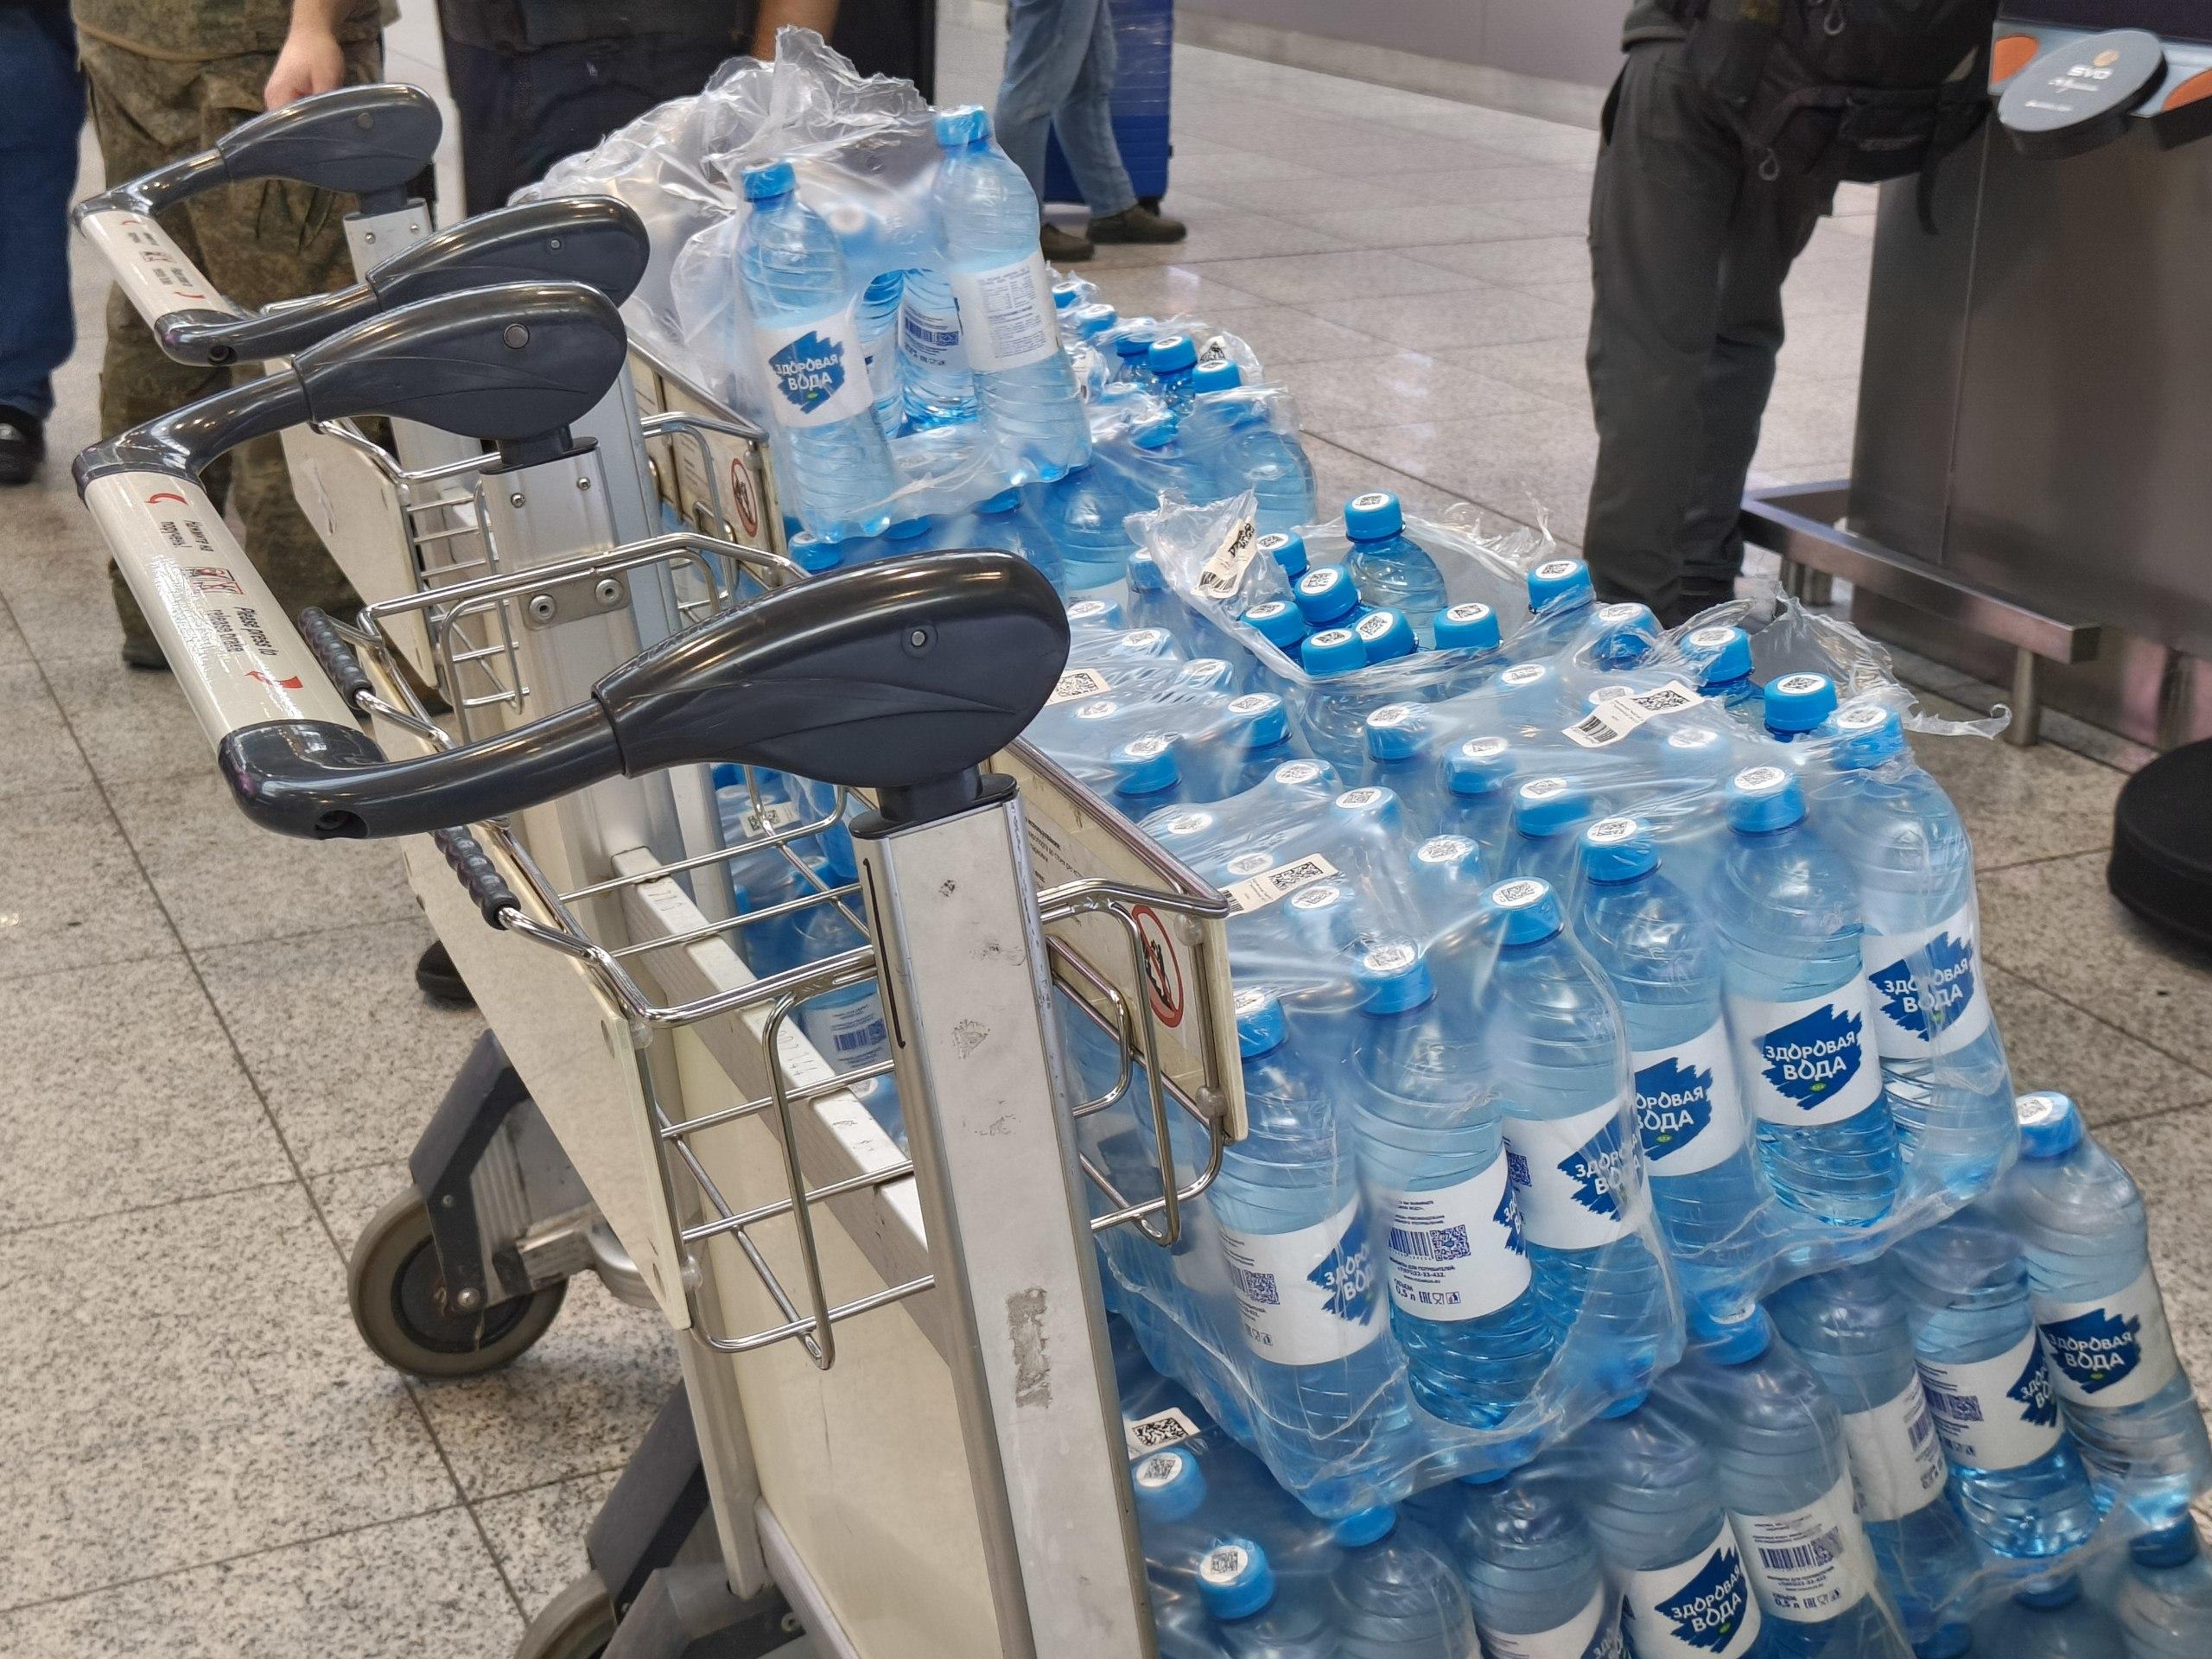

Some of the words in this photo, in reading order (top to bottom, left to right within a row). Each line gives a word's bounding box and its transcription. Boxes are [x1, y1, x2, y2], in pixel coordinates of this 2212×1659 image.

[775, 354, 838, 375] ЗДОРОВАЯ
[788, 372, 833, 391] ВОДА
[207, 609, 233, 632] release
[233, 607, 260, 628] Please
[240, 627, 272, 648] press
[1884, 958, 1968, 995] ЗДООВАЯ
[1903, 983, 1963, 1013] ВОДА
[1765, 1031, 1855, 1062] ЗДОРОВАЯ
[1783, 1056, 1847, 1081] ВОДА
[1636, 1086, 1704, 1109] ОРОВАЯ
[2048, 1332, 2133, 1352] ЗДОРОВАЯ
[2065, 1351, 2125, 1370] ВОДА
[1671, 1564, 1740, 1618] ЗДОРОВАЯ
[1691, 1592, 1742, 1632] ВОДА
